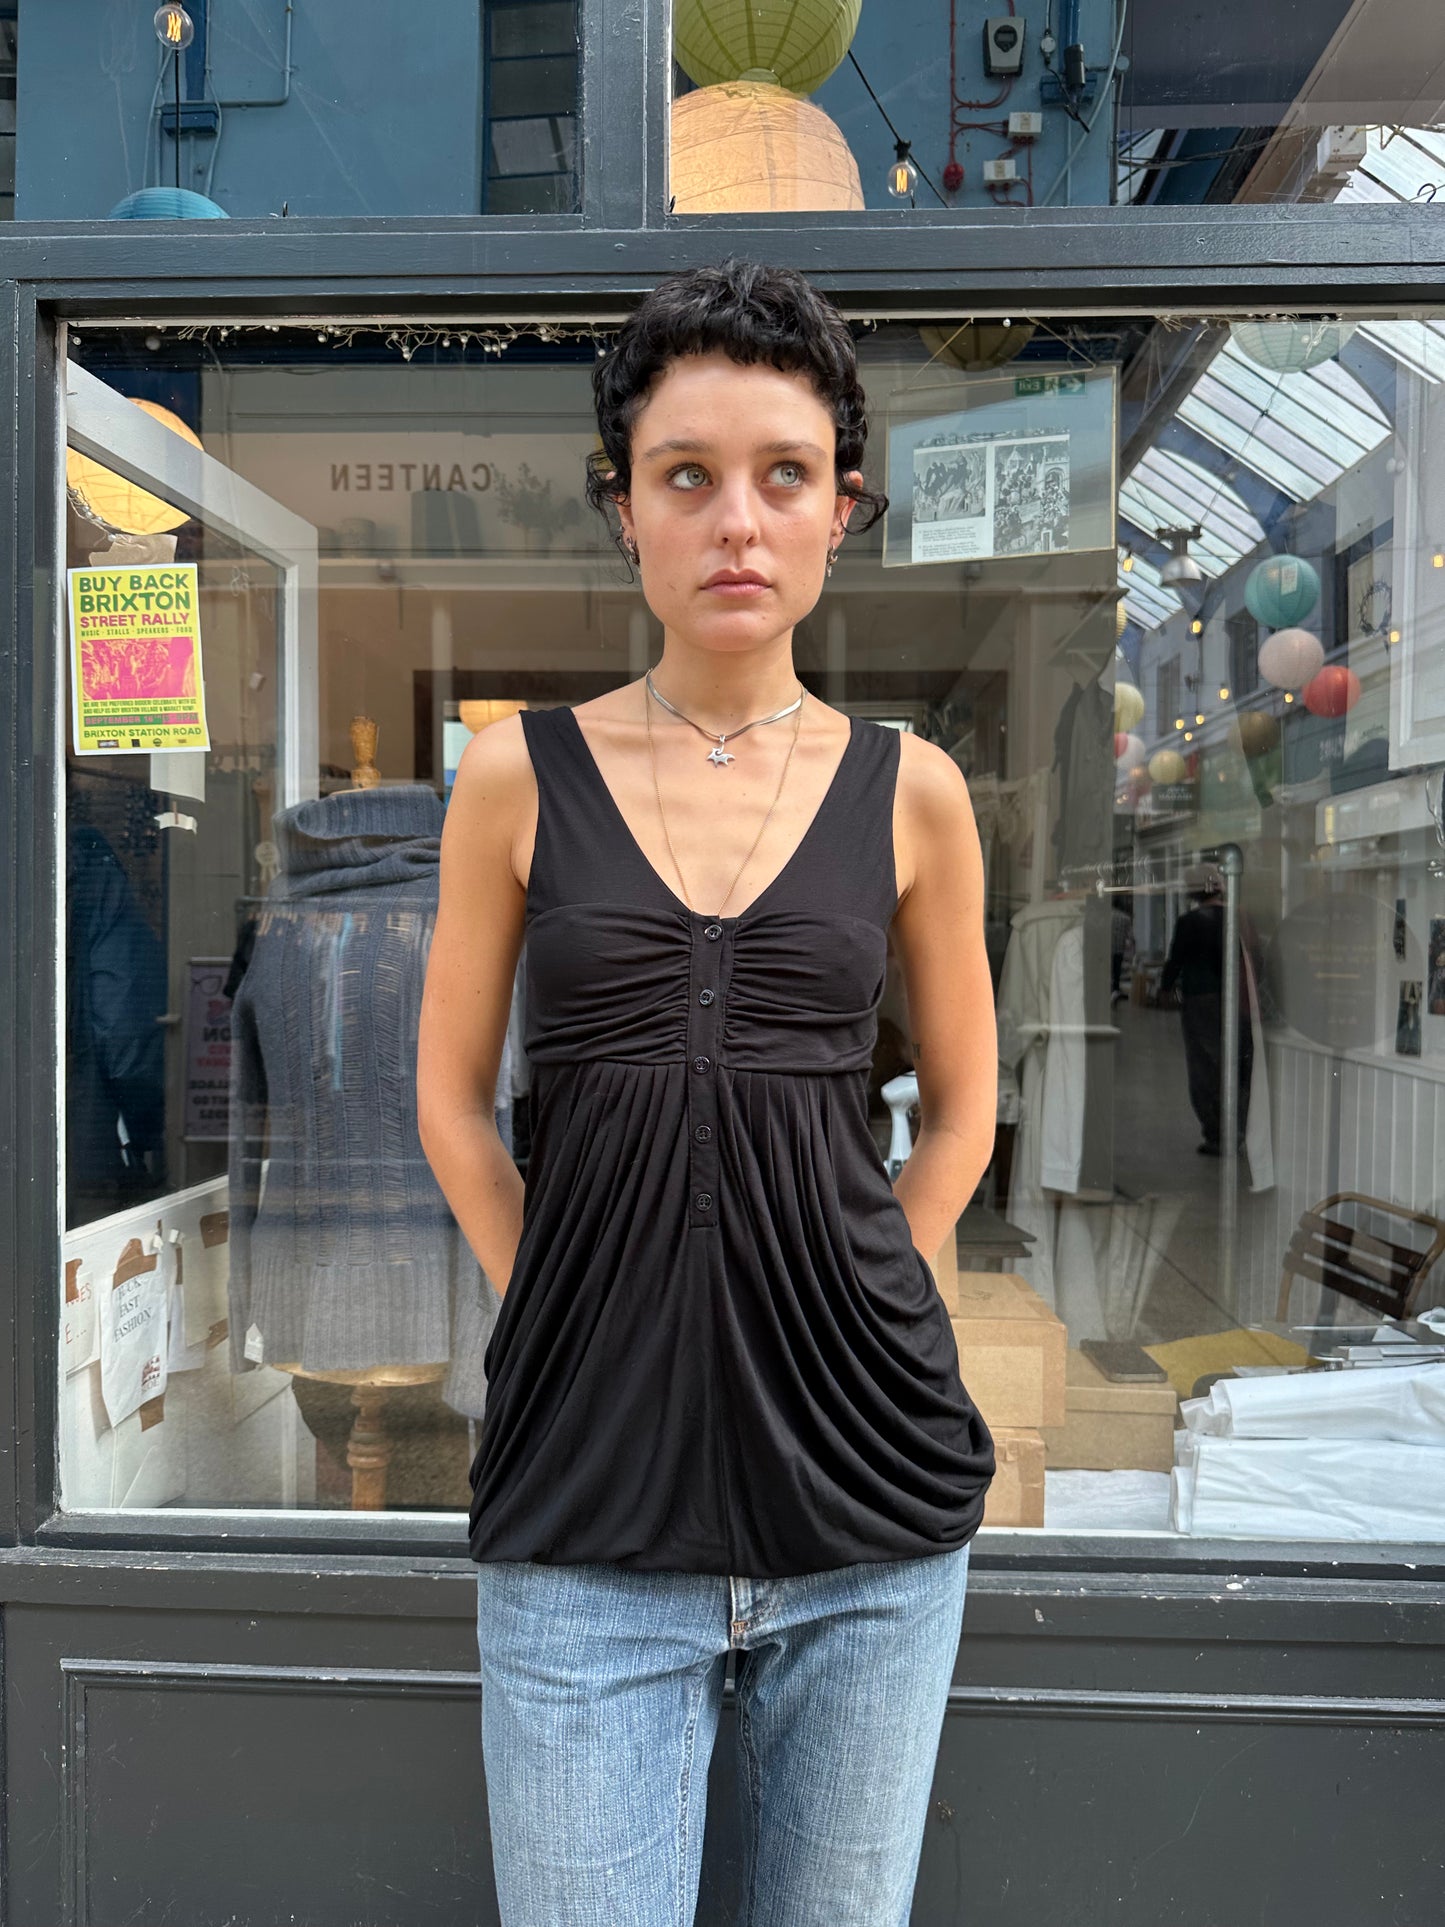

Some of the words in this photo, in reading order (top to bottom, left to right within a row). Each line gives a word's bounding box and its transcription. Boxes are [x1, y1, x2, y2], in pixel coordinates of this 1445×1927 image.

[79, 576, 122, 593] BUY
[129, 573, 189, 590] BACK
[80, 591, 191, 613] BRIXTON
[80, 614, 136, 628] STREET
[141, 612, 189, 626] RALLY
[81, 629, 100, 637] MUSIC
[107, 628, 130, 636] STALLS
[136, 627, 169, 635] SPEAKERS
[85, 716, 140, 725] SEPTEMBER
[84, 729, 126, 738] BRIXTON
[128, 728, 170, 737] STATION
[173, 727, 202, 735] ROAD
[119, 1294, 140, 1318] FAST
[114, 1306, 152, 1343] FASHION
